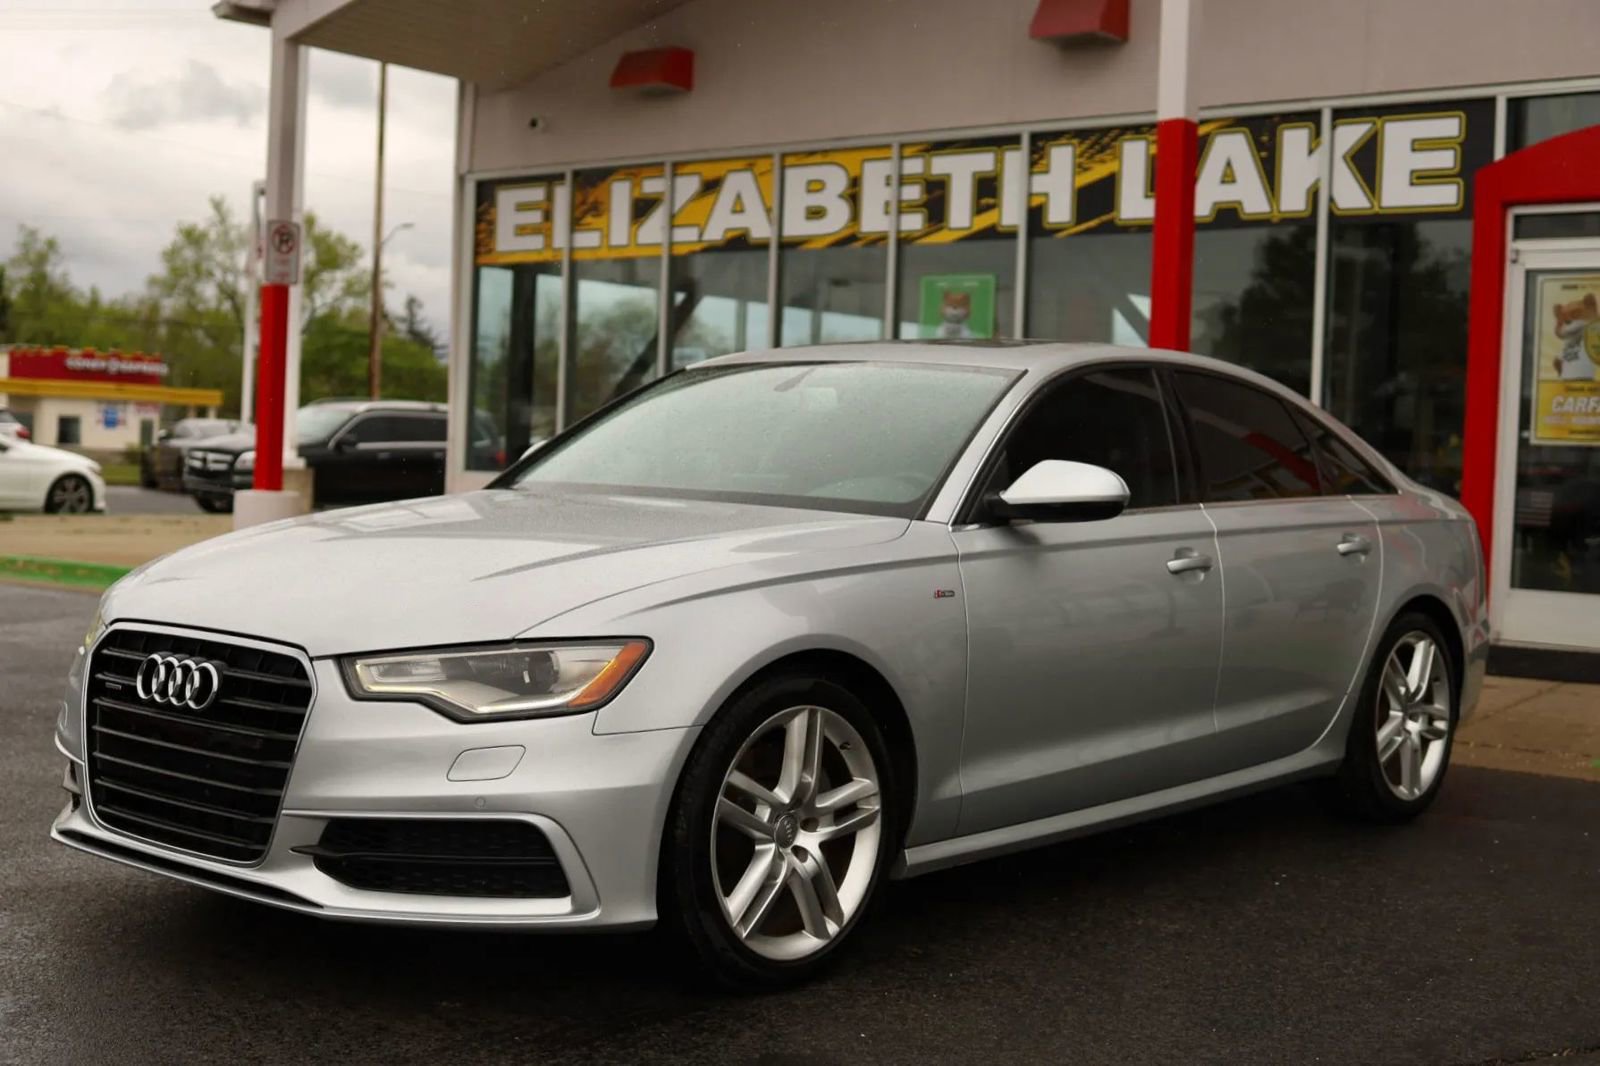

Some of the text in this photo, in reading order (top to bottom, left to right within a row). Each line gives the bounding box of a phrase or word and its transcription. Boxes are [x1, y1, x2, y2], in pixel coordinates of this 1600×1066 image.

[494, 113, 1466, 253] ELIZABETH LAKE
[1551, 395, 1600, 413] CARF
